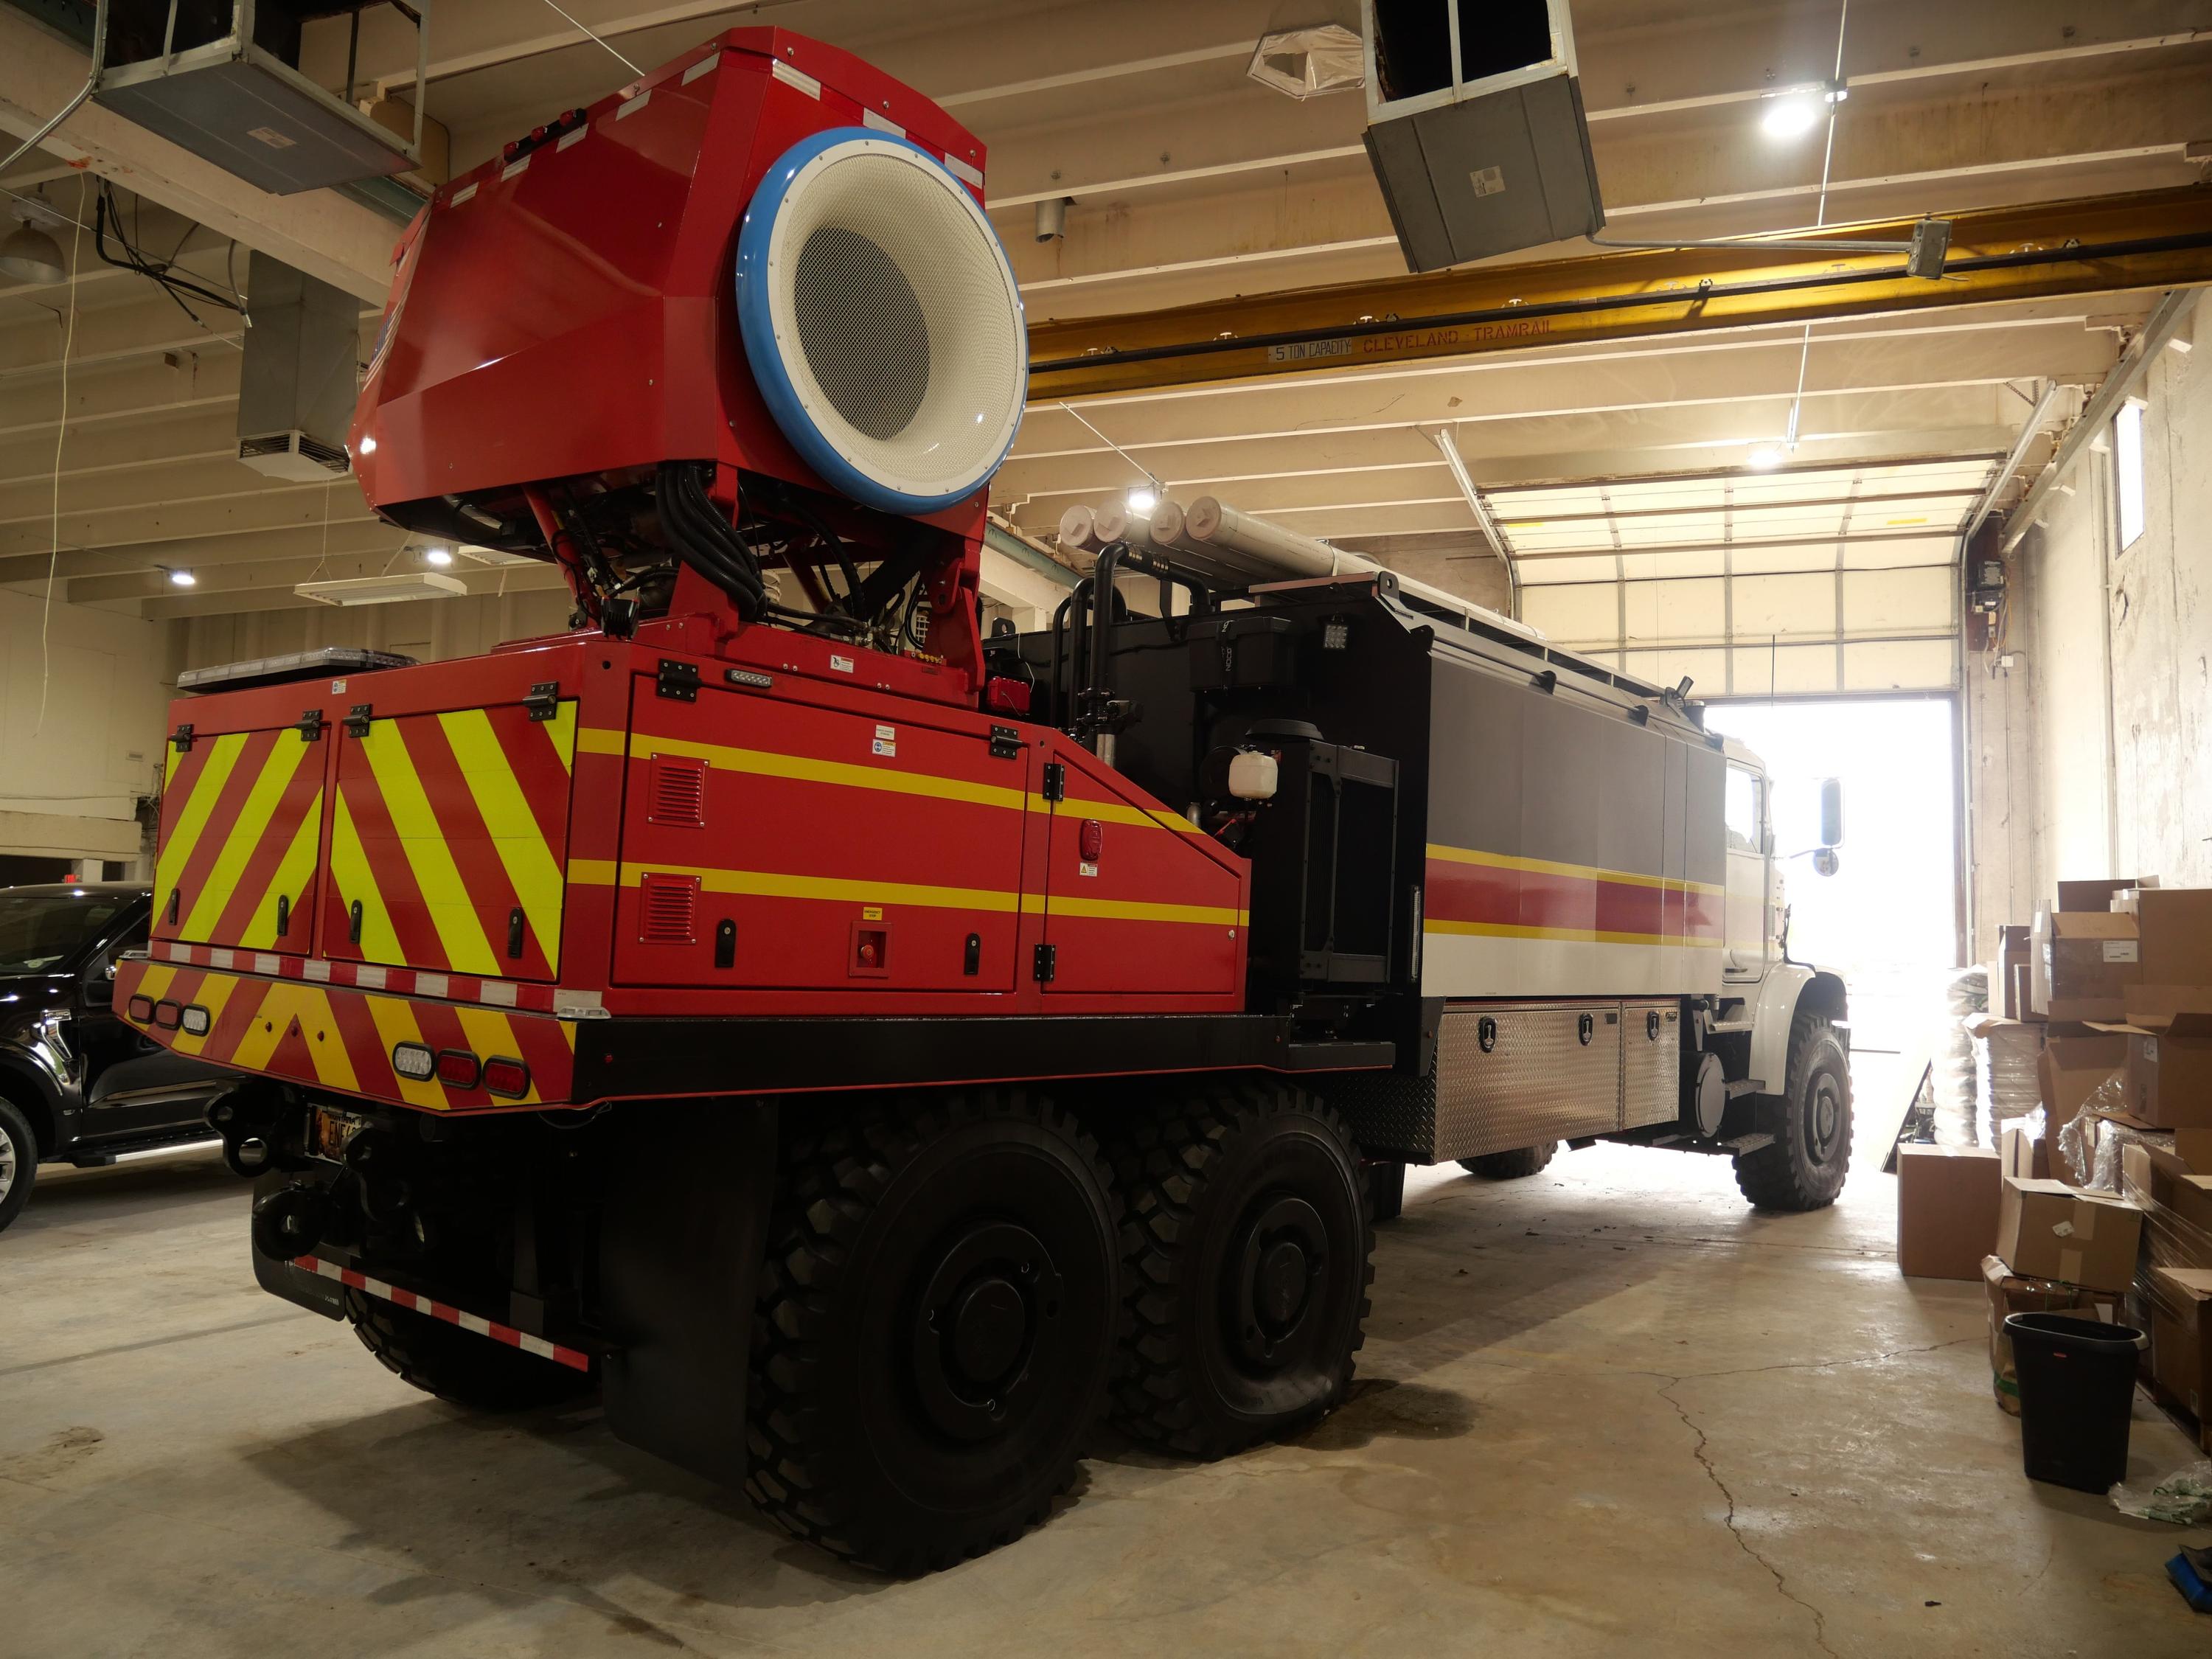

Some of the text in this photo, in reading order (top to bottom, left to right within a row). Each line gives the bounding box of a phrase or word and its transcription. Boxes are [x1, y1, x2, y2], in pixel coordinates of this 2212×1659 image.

[1276, 339, 1351, 361] 5 TON CAPACITY
[1364, 320, 1557, 353] CLEVELAND TRAMRAIL
